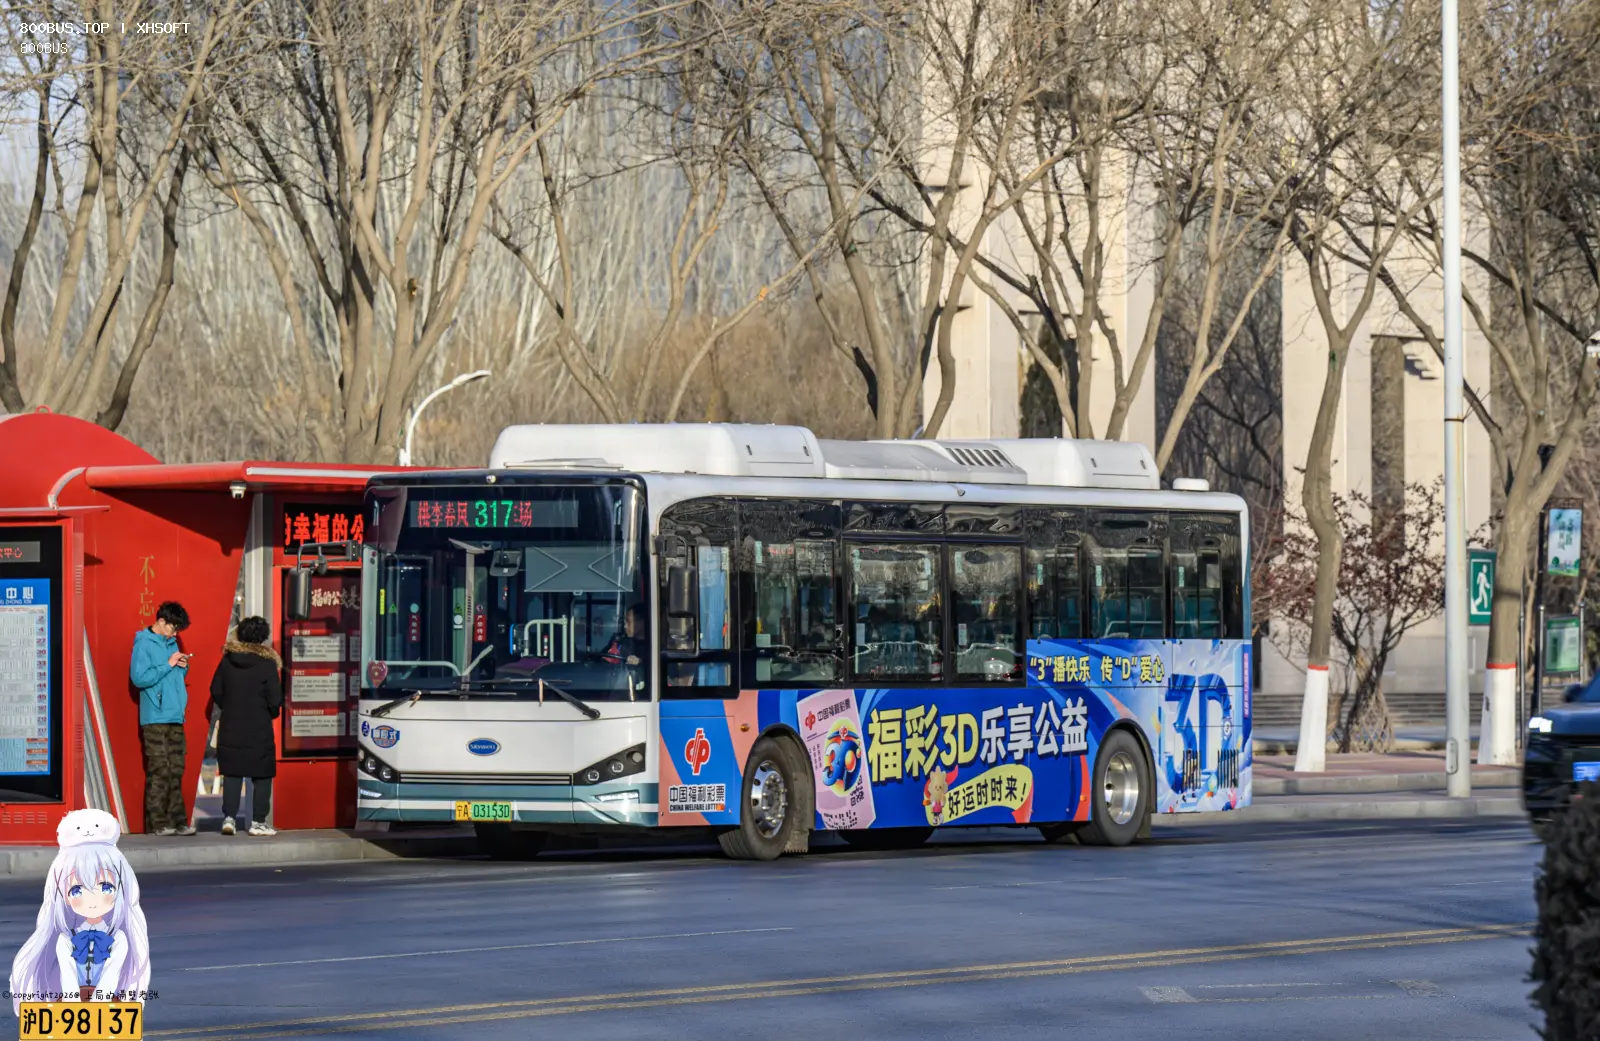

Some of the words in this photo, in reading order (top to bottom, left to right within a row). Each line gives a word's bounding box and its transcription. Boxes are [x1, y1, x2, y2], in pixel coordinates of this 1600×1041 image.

[475, 500, 513, 528] 317
[5, 586, 34, 600] 中心
[139, 555, 155, 628] 不忘
[867, 697, 1089, 784] 福彩3D乐享公益
[669, 785, 725, 803] 中国福利彩票
